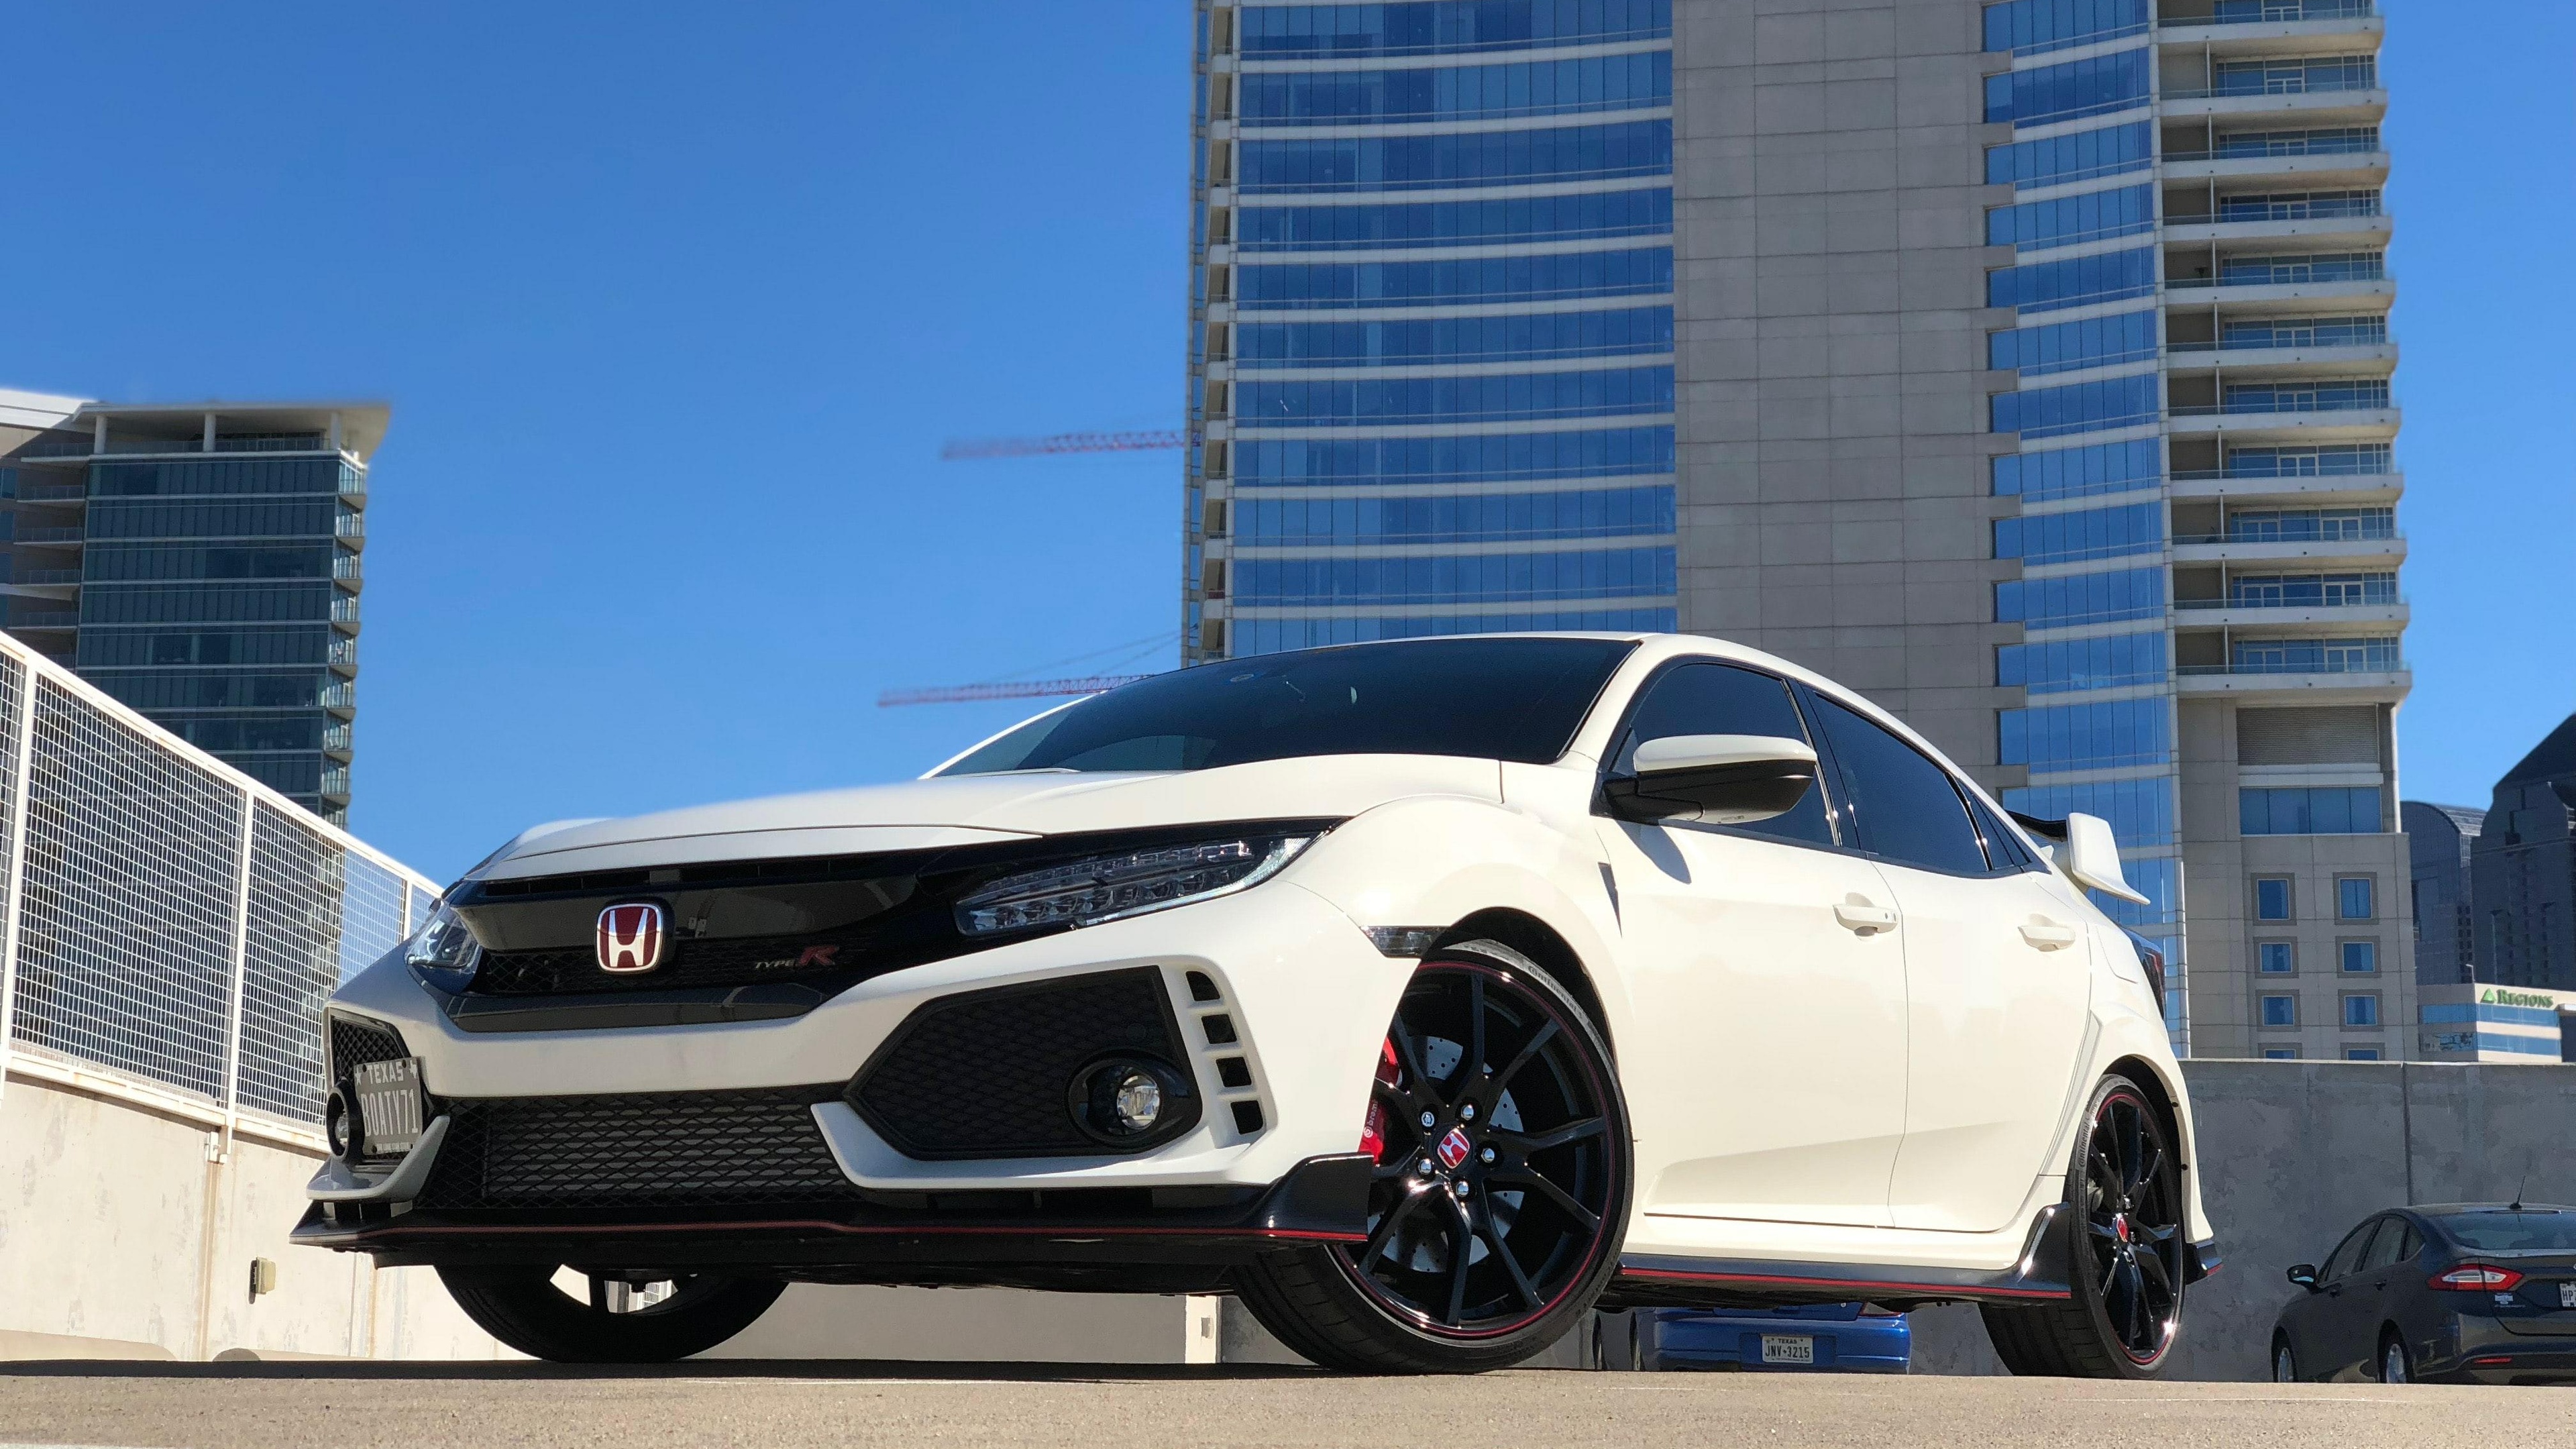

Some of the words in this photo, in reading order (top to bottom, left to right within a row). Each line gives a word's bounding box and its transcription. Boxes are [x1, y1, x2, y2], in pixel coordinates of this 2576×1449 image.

[2496, 989, 2554, 1008] REGIONS
[366, 1061, 404, 1084] TEXAS
[361, 1088, 419, 1137] BOATY71
